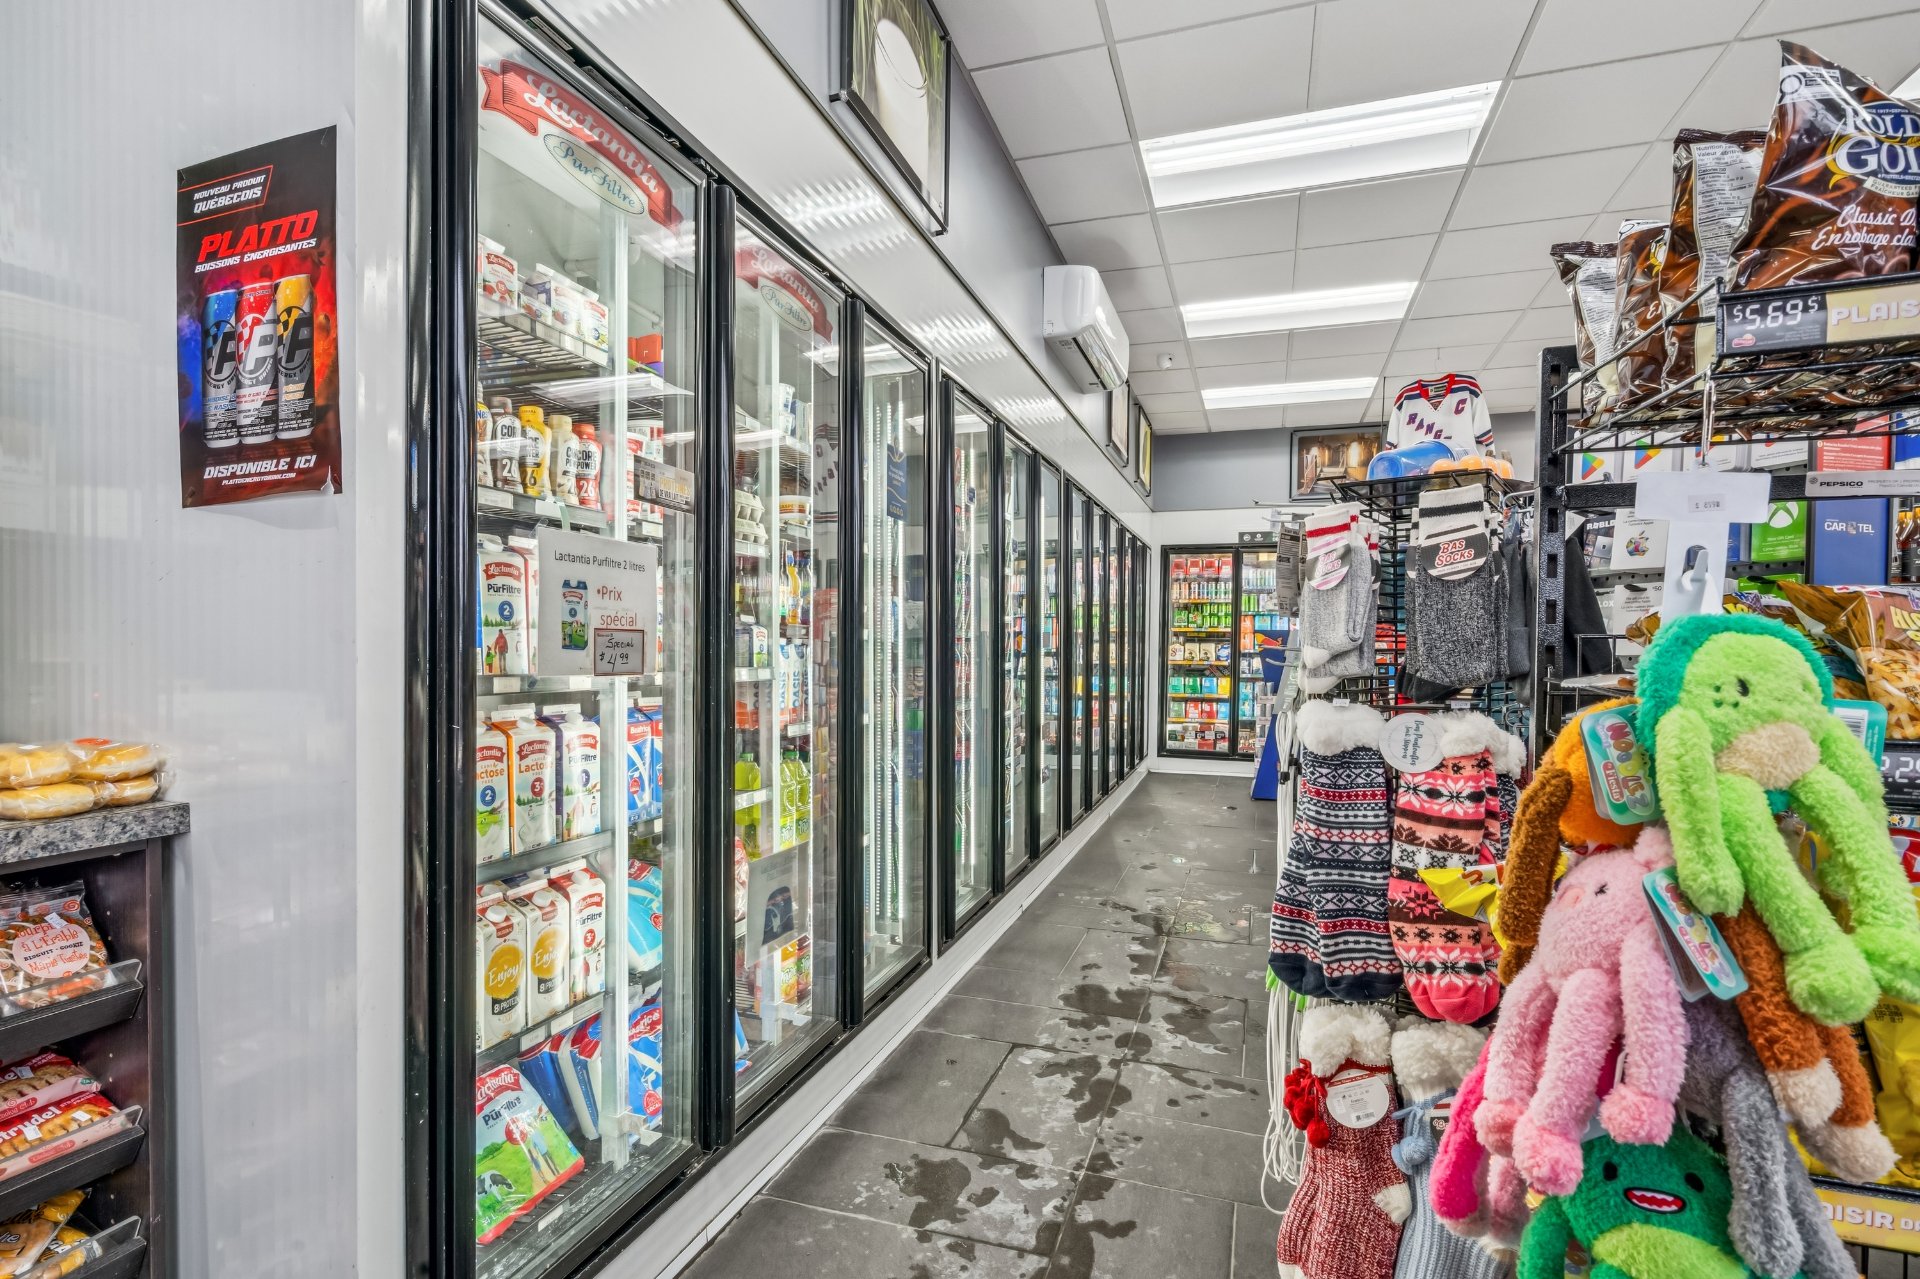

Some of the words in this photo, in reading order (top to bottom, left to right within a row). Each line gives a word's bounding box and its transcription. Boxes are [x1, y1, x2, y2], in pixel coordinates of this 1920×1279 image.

[523, 74, 658, 194] Lactantia
[194, 184, 231, 200] NOUVEAU
[232, 175, 266, 190] PRODUIT
[1872, 180, 1913, 191] GUARANTEED
[1836, 204, 1896, 227] Classic
[197, 210, 319, 262] PLATTO
[1811, 226, 1889, 251] Enrobage
[1890, 229, 1916, 247] cla
[194, 256, 241, 273] BOISSONS
[1831, 300, 1920, 327] PLAIS
[1453, 398, 1468, 416] C
[203, 457, 291, 479] DISPONIBLE
[294, 455, 317, 468] ICI
[503, 458, 518, 478] 26
[580, 480, 595, 497] 26
[1439, 540, 1465, 555] BAS
[554, 550, 591, 566] Lactantia
[592, 554, 622, 570] Purfiltre
[623, 560, 628, 570] 2
[629, 560, 646, 573] litres
[1435, 549, 1474, 567] SOCKS
[601, 585, 623, 602] Prix
[600, 612, 638, 630] spécial
[792, 670, 800, 708] OASIS
[24, 949, 54, 962] BISCUIT
[60, 941, 84, 951] COOKIE
[28, 959, 58, 974] Maple
